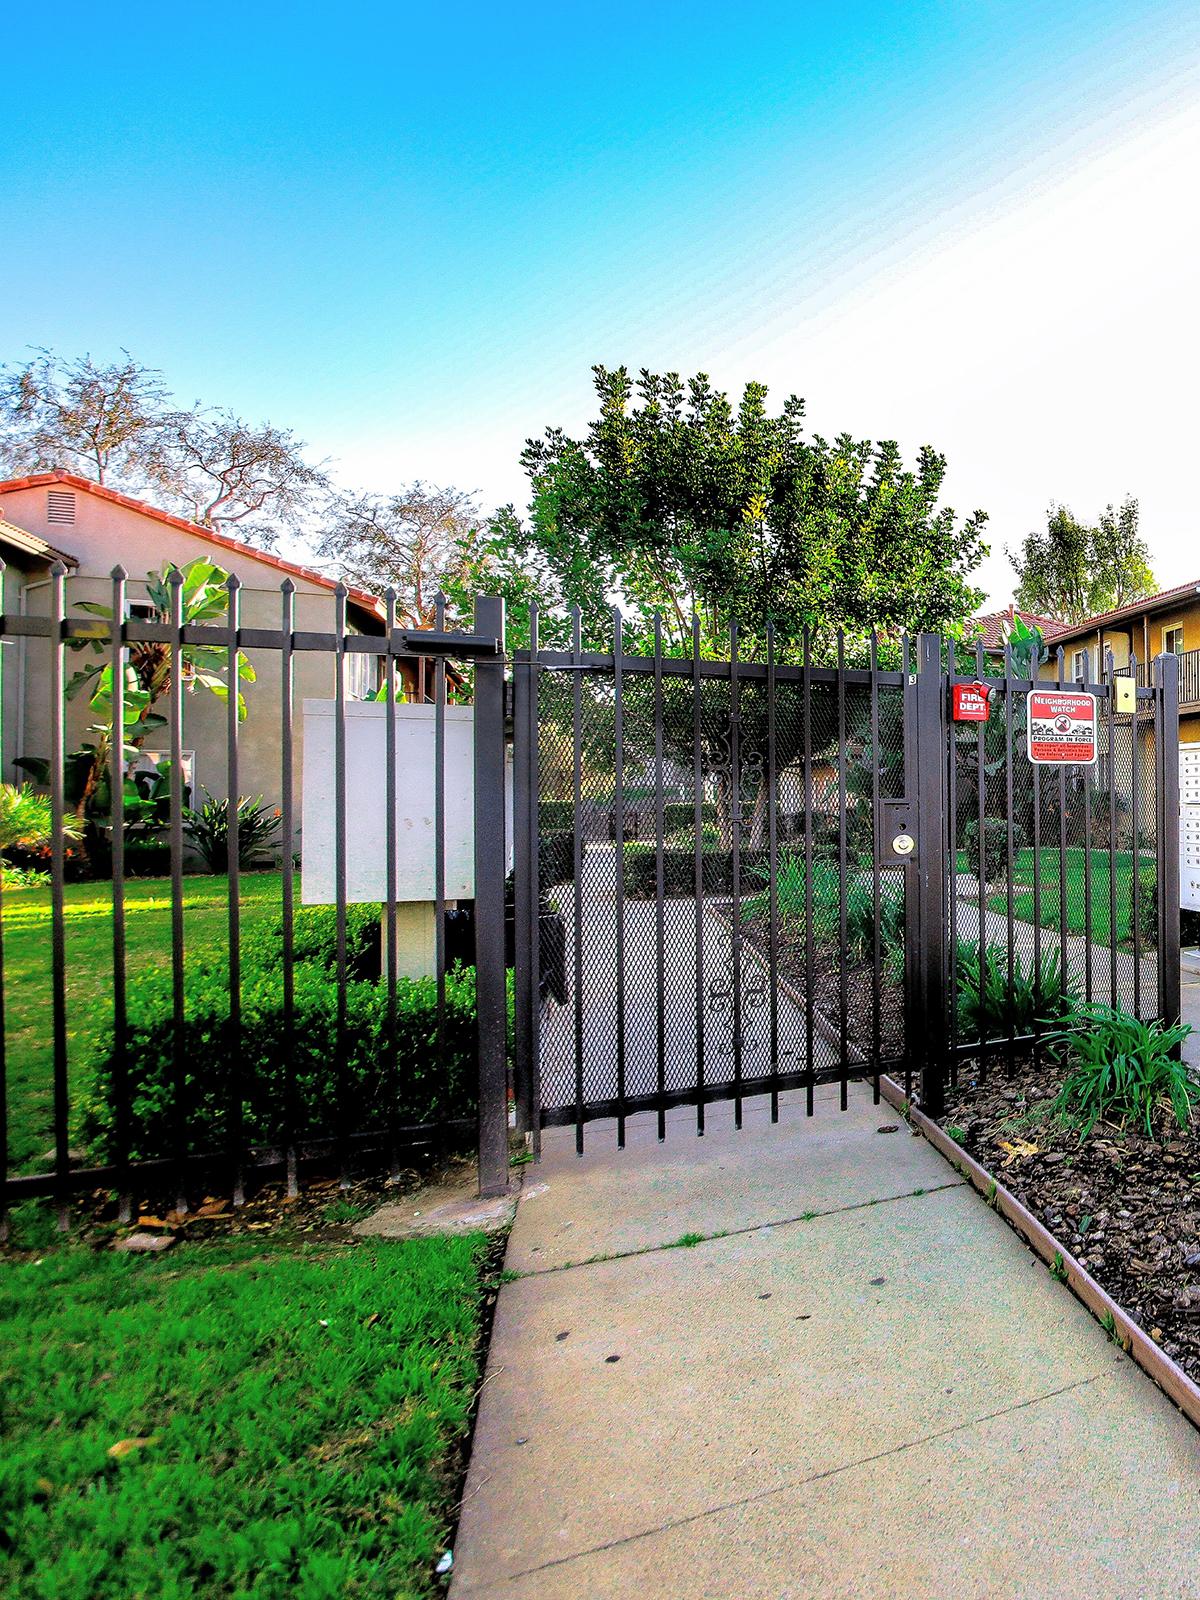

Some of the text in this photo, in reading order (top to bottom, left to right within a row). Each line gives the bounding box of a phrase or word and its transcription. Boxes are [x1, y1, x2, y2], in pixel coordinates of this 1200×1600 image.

[910, 675, 915, 683] 3
[961, 693, 984, 701] FIRE
[1034, 696, 1091, 706] NEIGHBORHOOD
[960, 702, 986, 711] DEPT.
